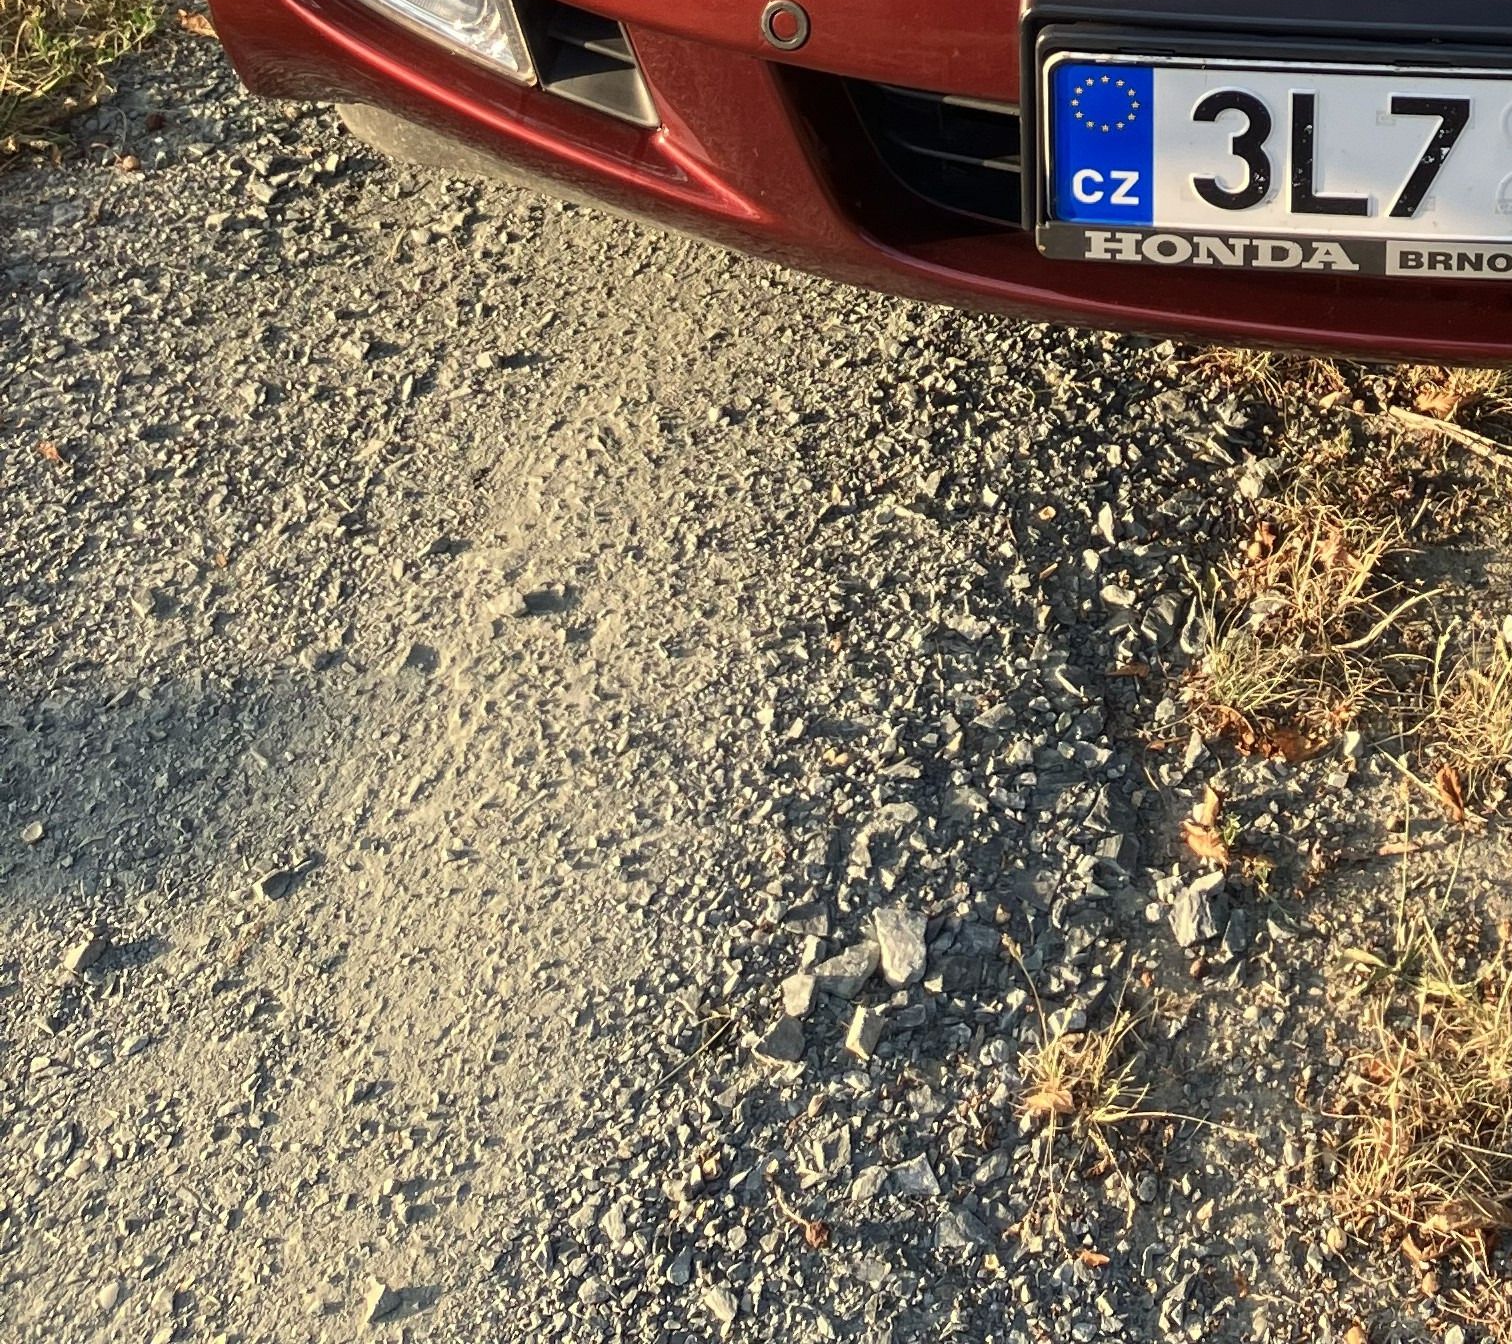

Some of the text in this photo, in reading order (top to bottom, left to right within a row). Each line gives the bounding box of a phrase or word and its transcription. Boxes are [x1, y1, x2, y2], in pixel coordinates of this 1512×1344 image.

[1192, 89, 1471, 218] 3L7
[1071, 168, 1140, 206] CZ
[1084, 230, 1360, 272] HONDA
